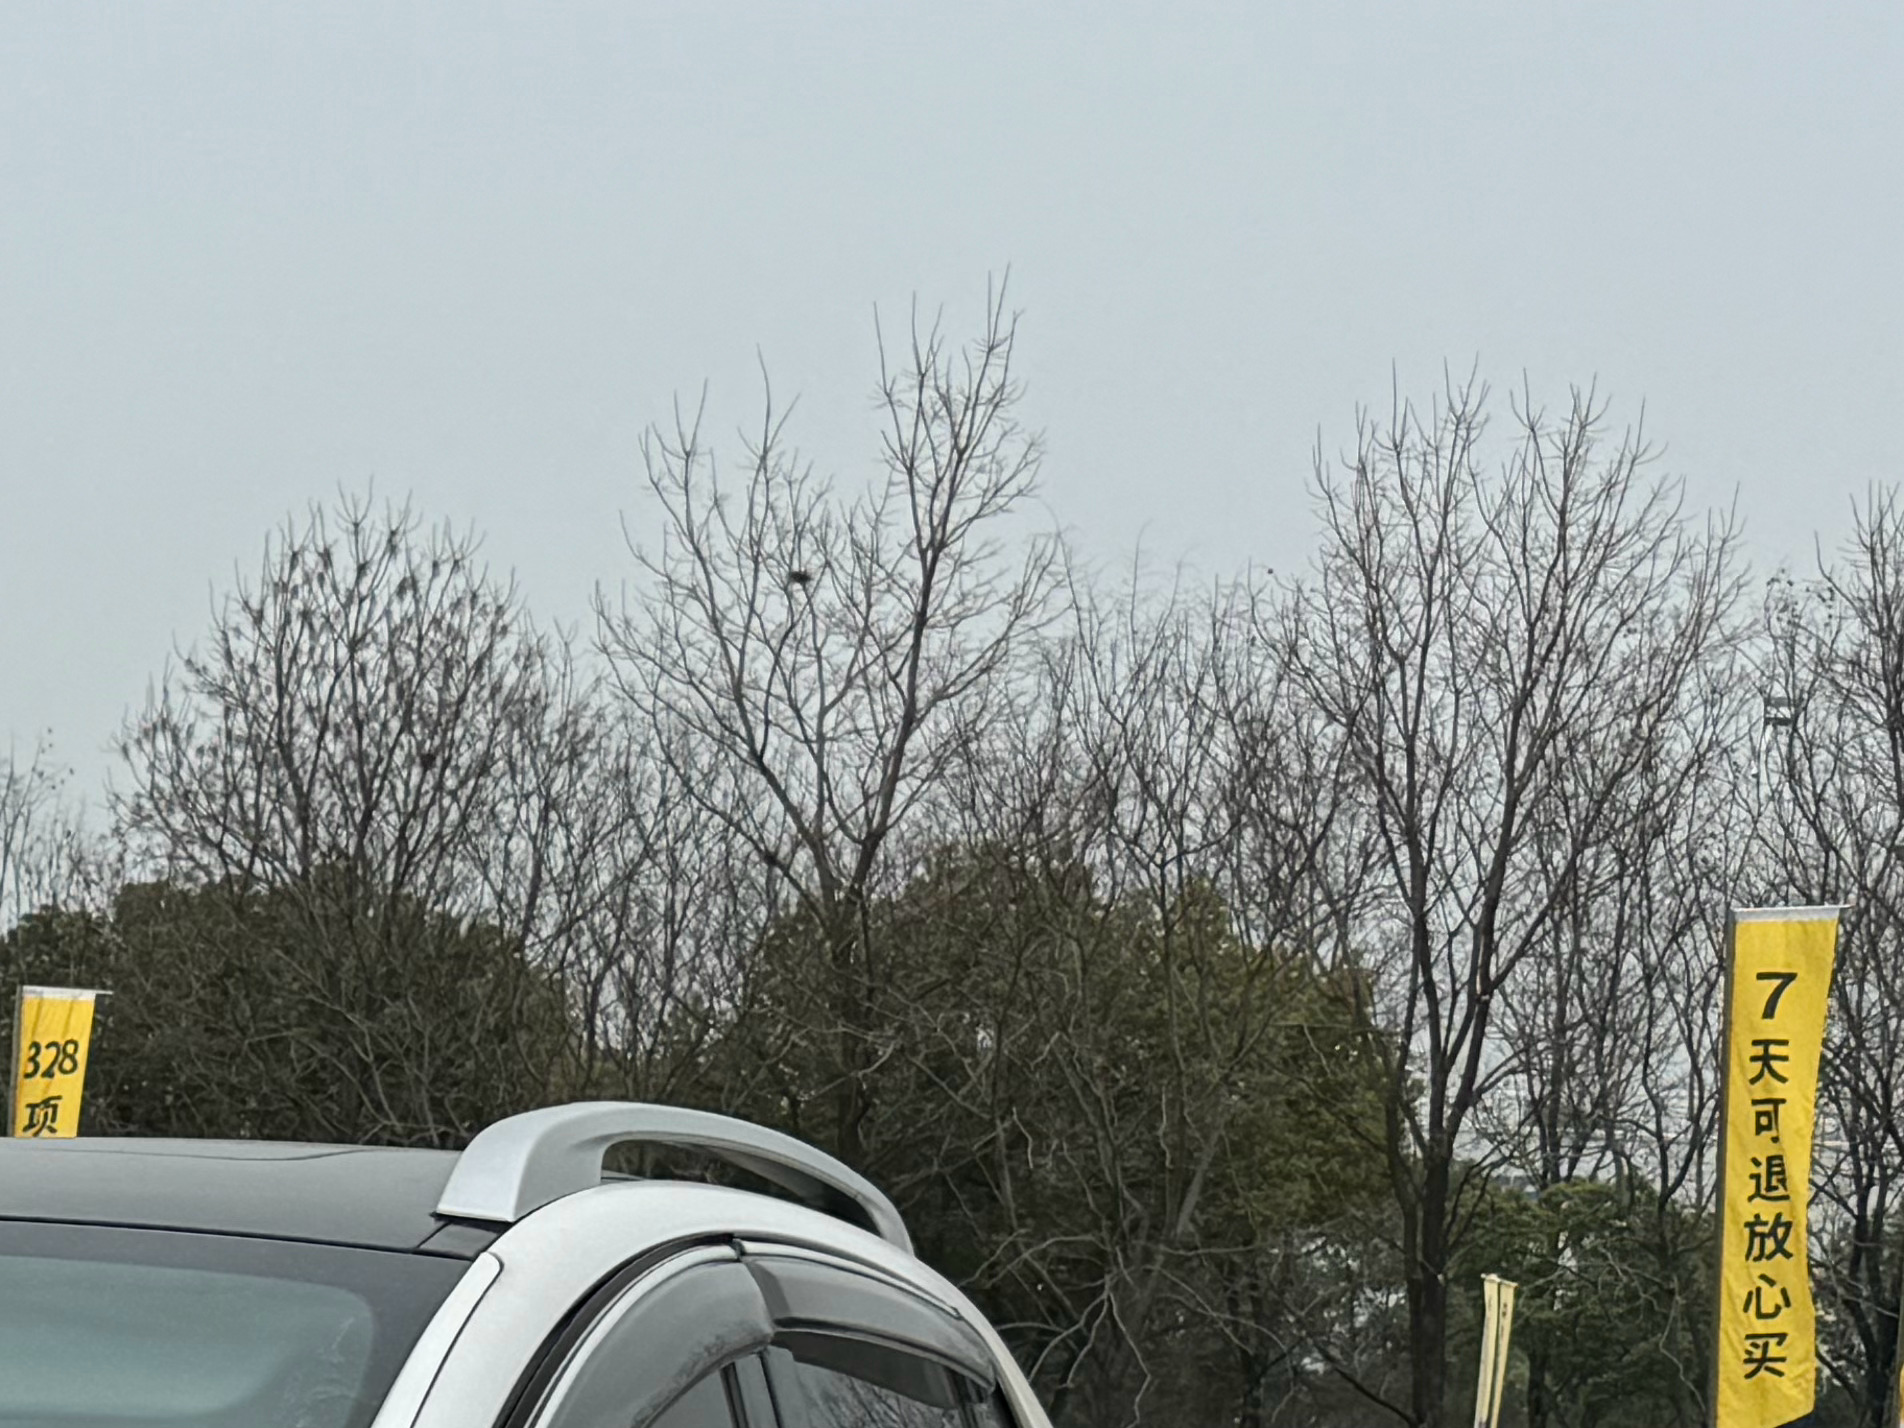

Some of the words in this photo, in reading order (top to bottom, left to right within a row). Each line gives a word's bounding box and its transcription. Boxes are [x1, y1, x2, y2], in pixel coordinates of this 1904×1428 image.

[1743, 972, 1797, 1380] 7天可退放心买
